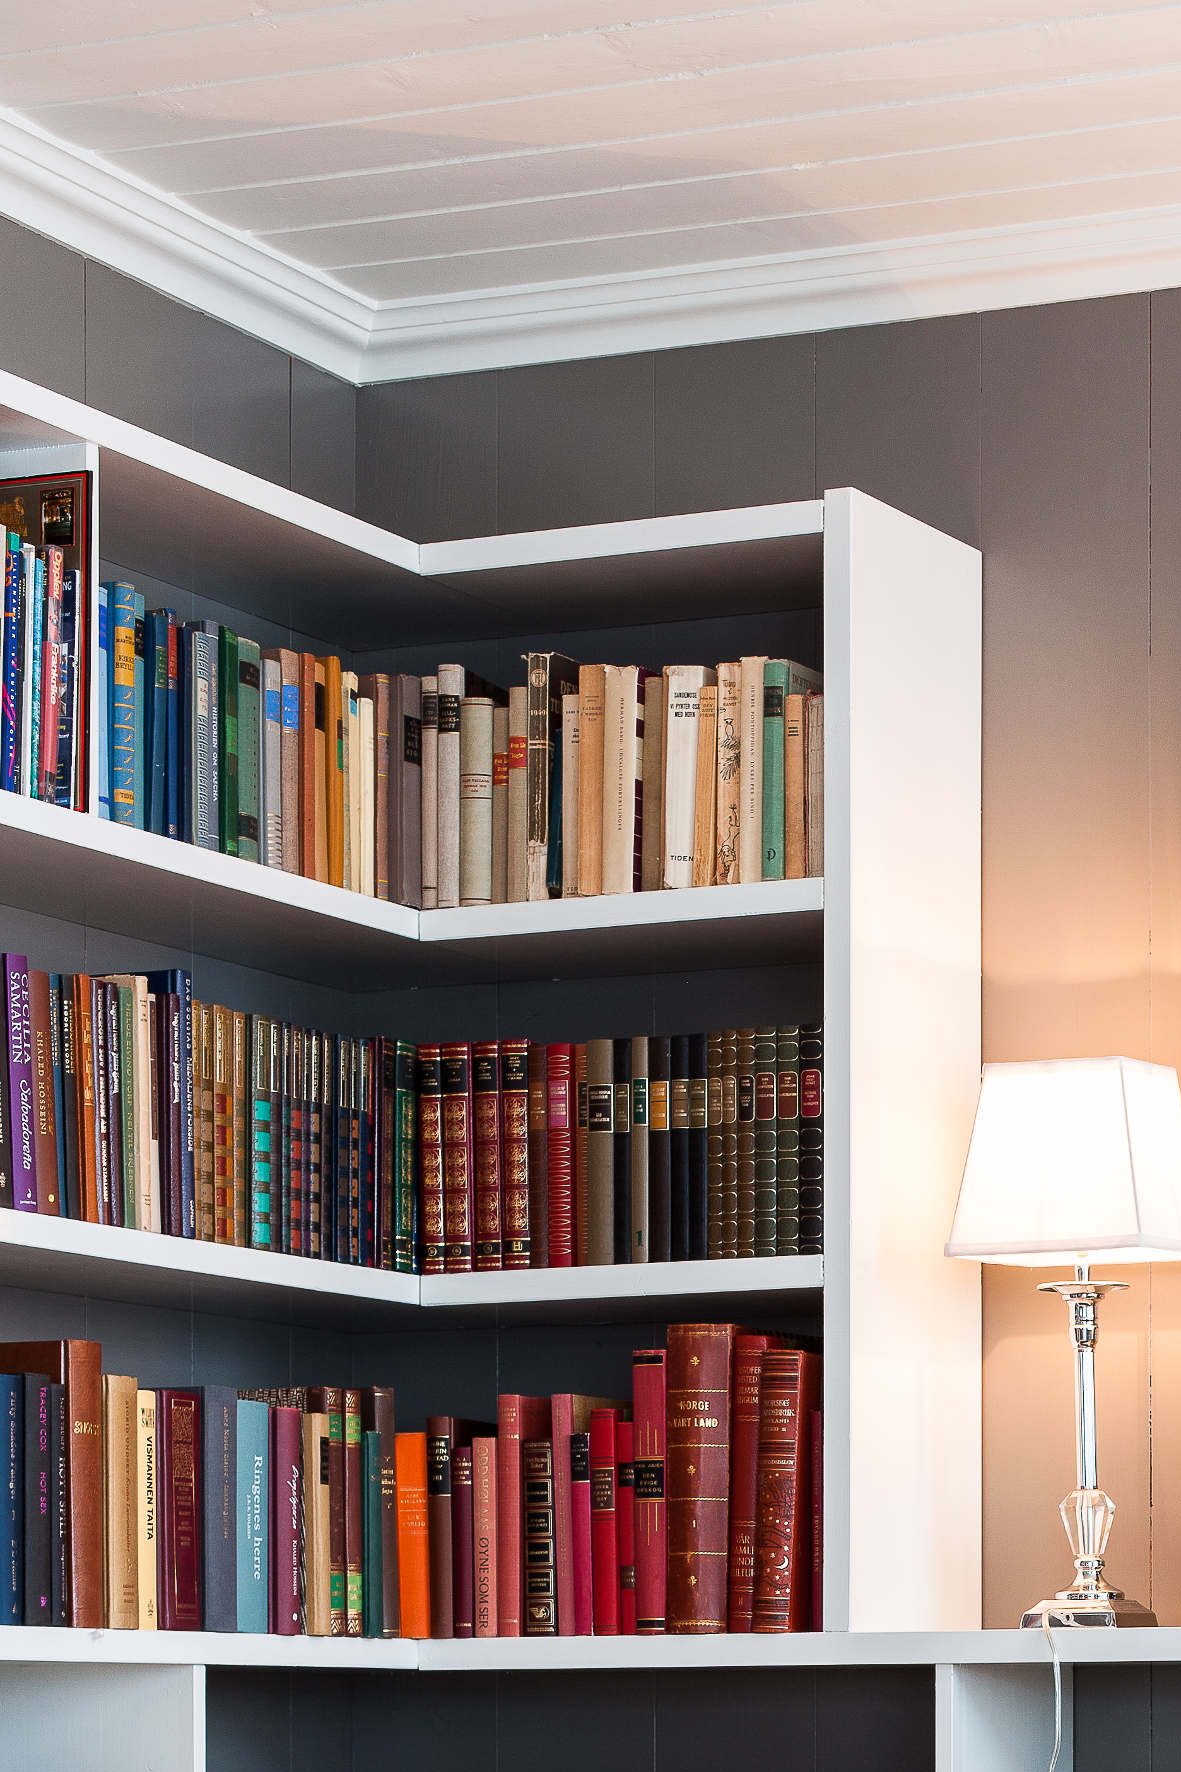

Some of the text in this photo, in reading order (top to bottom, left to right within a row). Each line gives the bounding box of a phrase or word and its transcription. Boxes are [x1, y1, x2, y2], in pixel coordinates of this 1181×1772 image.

[47, 643, 61, 705] Frankrike
[10, 972, 23, 1065] SAMARTIN
[20, 974, 33, 1065] CECILIA
[36, 1030, 48, 1137] KHALED HOSSEINI
[39, 1386, 48, 1496] TRACEY HOT
[679, 1400, 711, 1411] NORGE
[694, 1416, 719, 1428] LAND
[146, 1435, 155, 1541] VISMANNEN TAITA
[252, 1454, 264, 1582] Ringenes herre
[479, 1537, 490, 1629] ØYNE SOM SER
